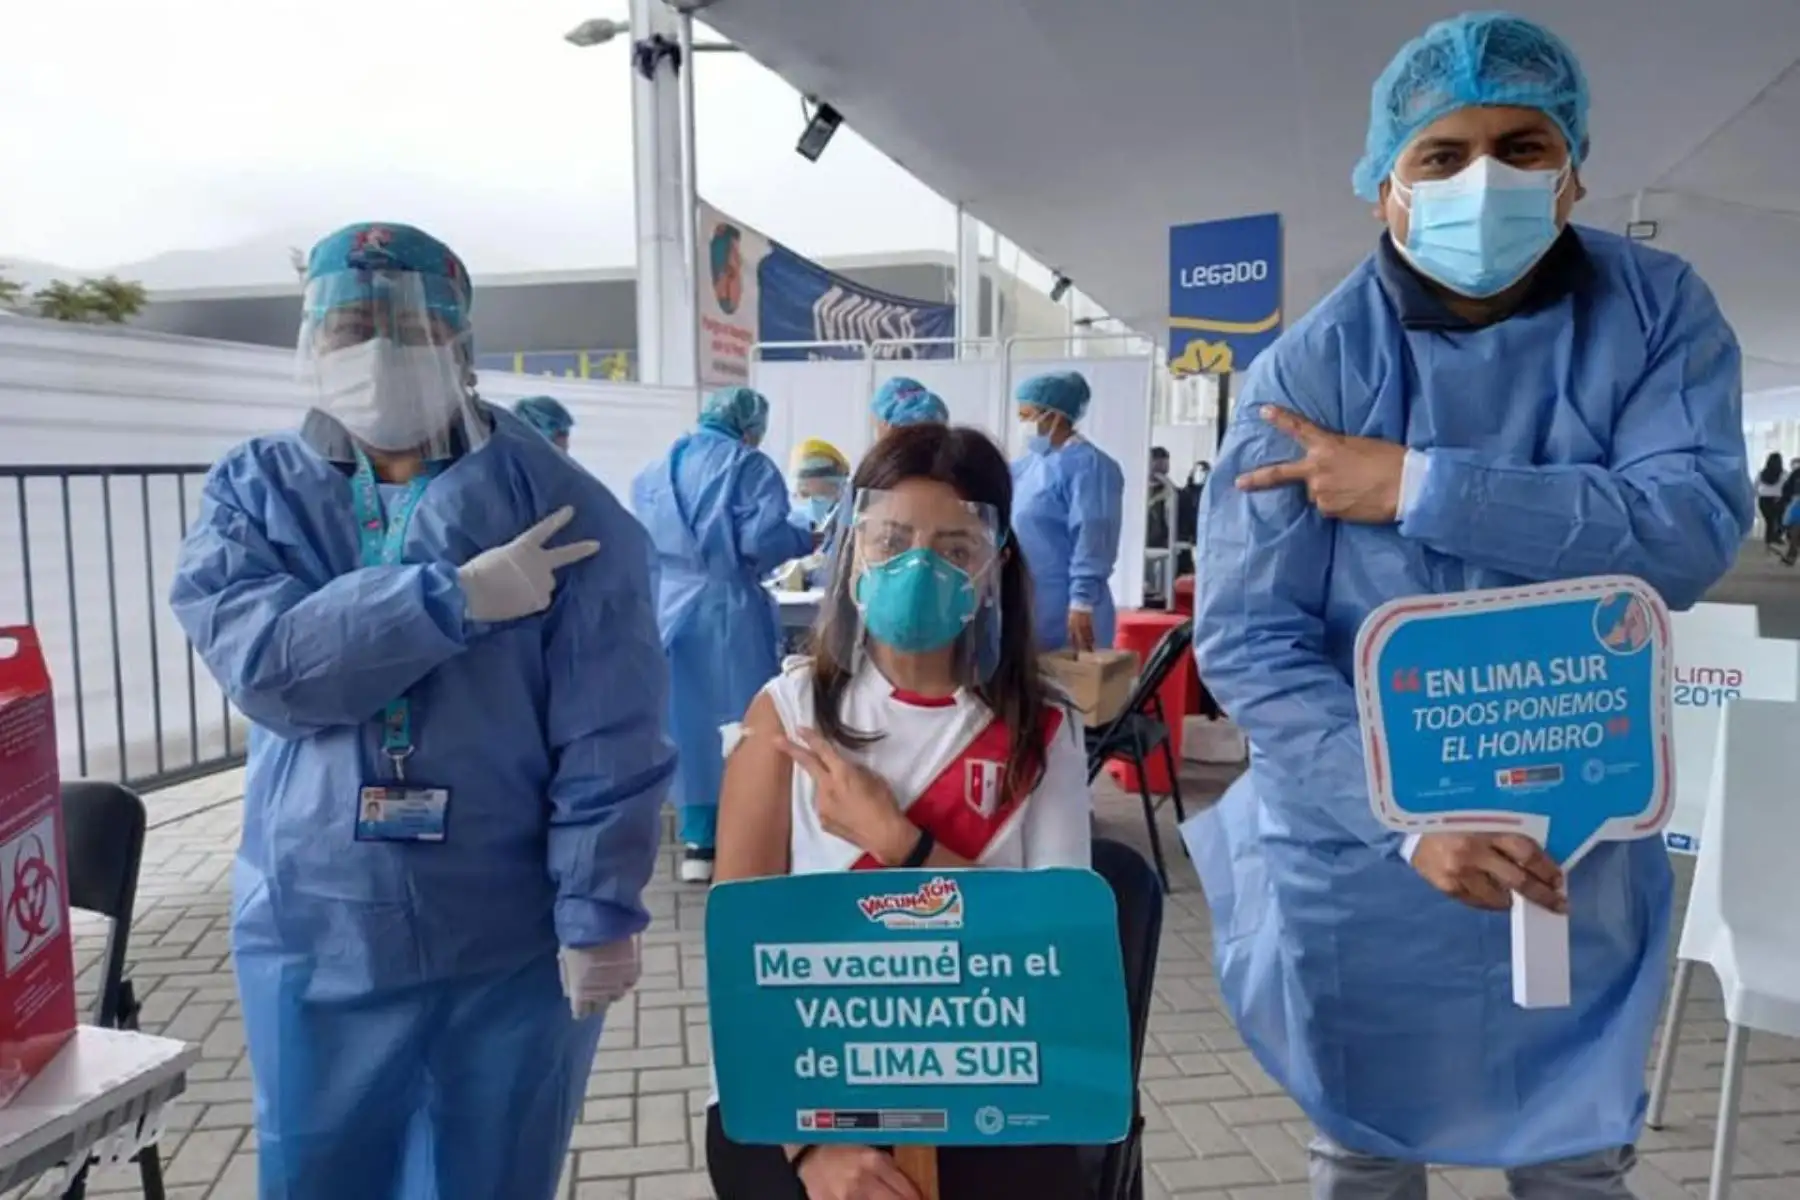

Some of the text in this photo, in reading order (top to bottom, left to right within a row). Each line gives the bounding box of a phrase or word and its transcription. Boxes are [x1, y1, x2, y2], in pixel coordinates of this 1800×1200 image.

[1472, 661, 1545, 694] LIMA
[1550, 654, 1609, 685] SUR
[1412, 688, 1628, 732] TODOS PONEMOS
[1441, 735, 1473, 763] EL
[860, 877, 957, 915] VACUNATÓN
[759, 945, 1061, 979] Me vacuné en el
[795, 988, 1026, 1029] VACUNATÓN
[794, 1046, 1034, 1078] de LIMA SUR
